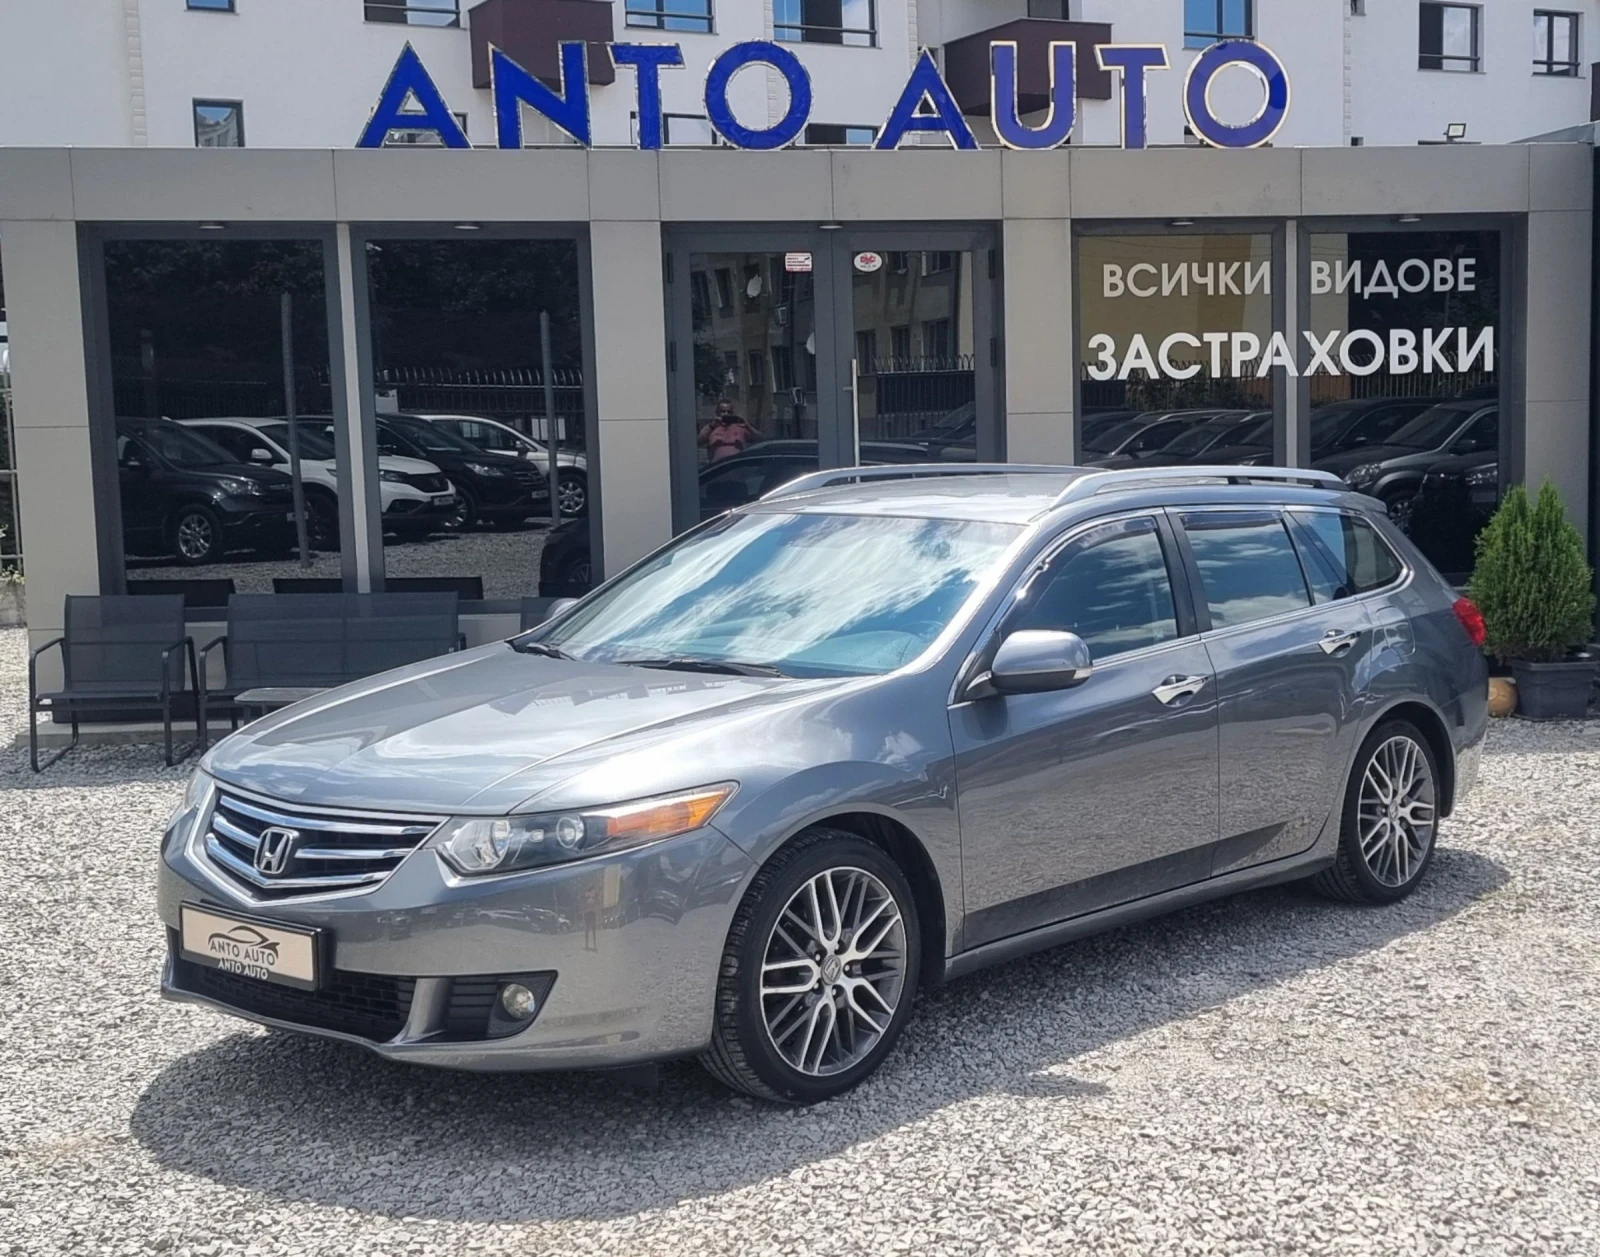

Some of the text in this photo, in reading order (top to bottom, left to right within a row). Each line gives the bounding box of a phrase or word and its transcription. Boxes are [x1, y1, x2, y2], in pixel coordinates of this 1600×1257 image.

[355, 38, 1291, 150] ANTO AUTO
[1103, 257, 1477, 299] ВСИЧКИ ВИДОВЕ
[1087, 326, 1495, 381] ЗАСТРАХОВКИ
[210, 940, 276, 966] ANTO AUTO
[218, 960, 268, 980] ANTO AUTO
